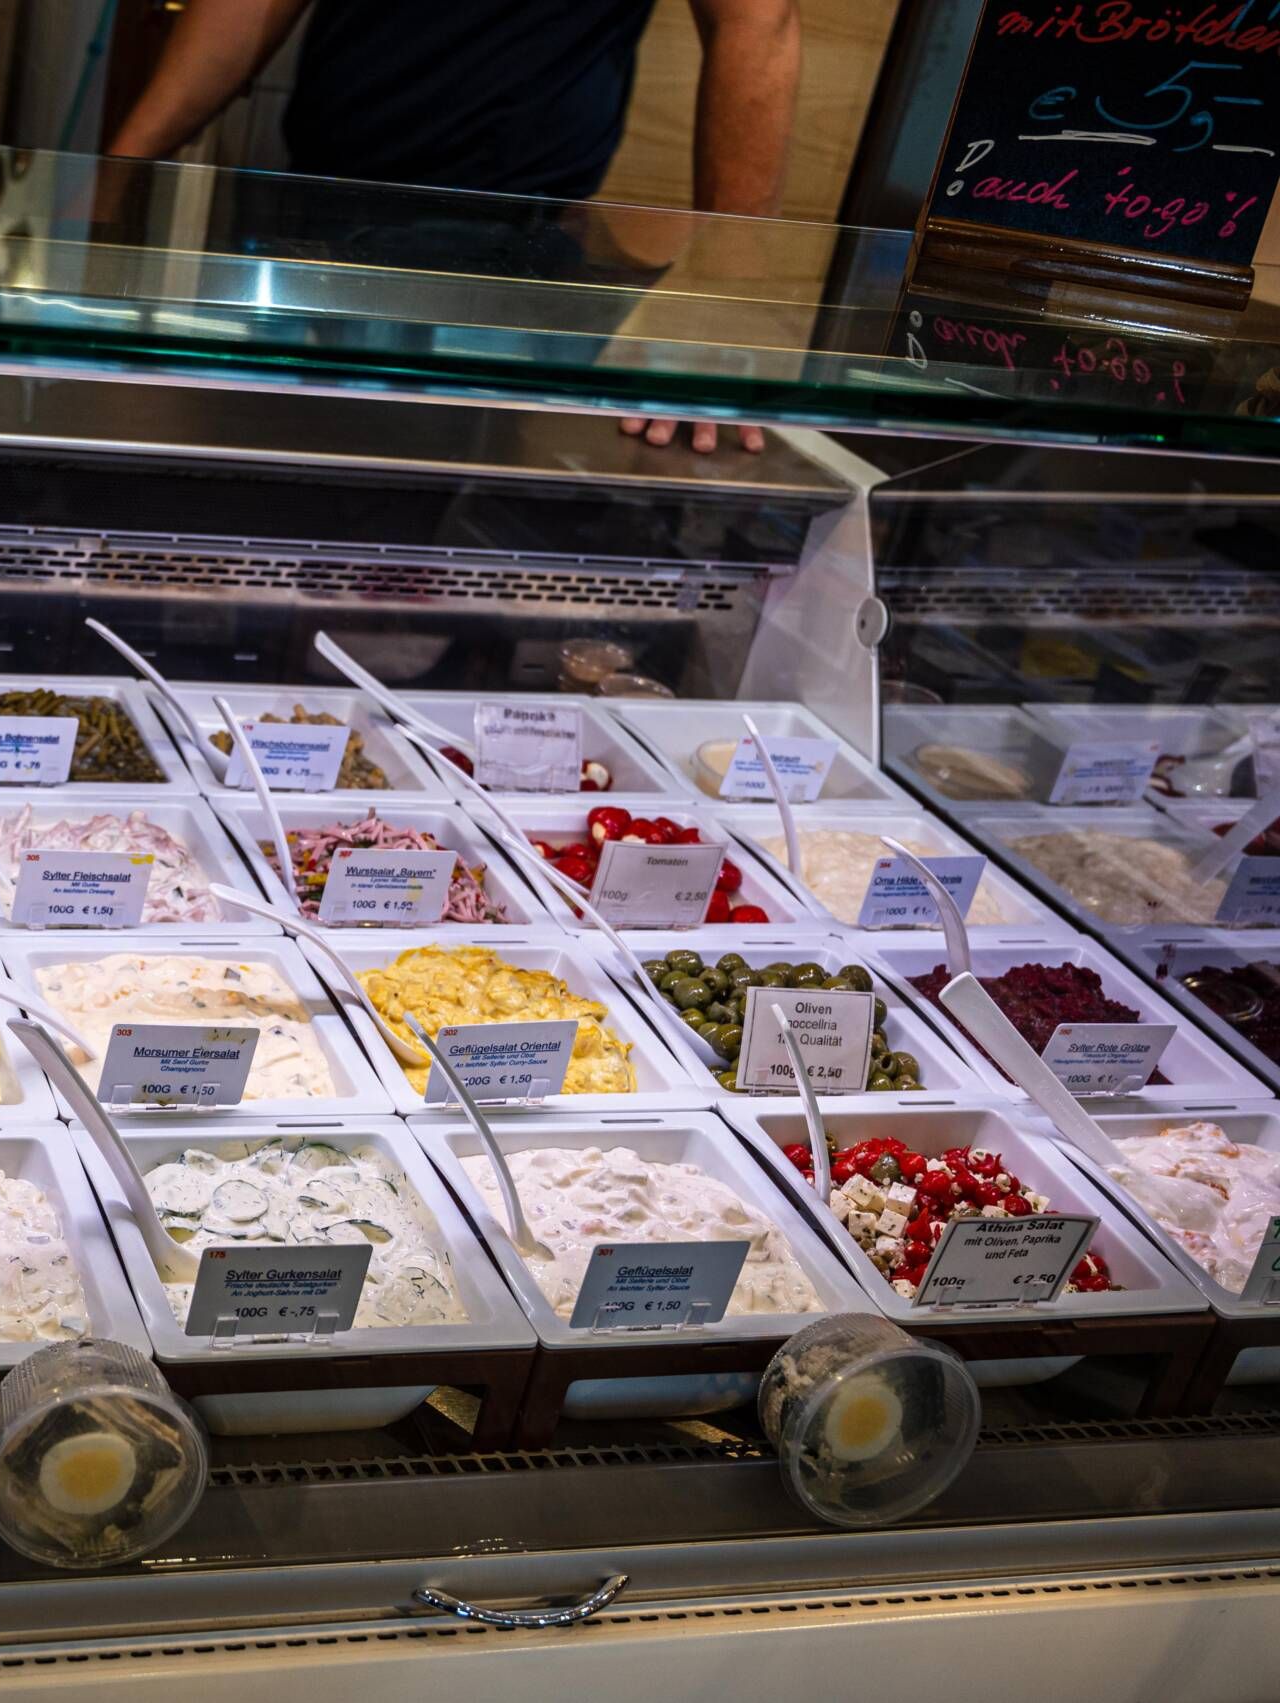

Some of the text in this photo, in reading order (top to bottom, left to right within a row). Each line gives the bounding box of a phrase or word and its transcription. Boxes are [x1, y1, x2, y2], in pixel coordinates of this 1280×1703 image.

[972, 169, 1079, 209] auch
[15, 760, 22, 769] €
[286, 766, 293, 775] €
[647, 856, 688, 866] Tomaten
[42, 870, 131, 882] Sylter Fleischsalat
[345, 866, 395, 877] Wurstsalat
[675, 892, 682, 901] €
[48, 905, 74, 914] 100G
[82, 906, 89, 914] €
[353, 900, 376, 908] 100G
[384, 901, 391, 909] €
[795, 1002, 832, 1014] Oliven
[116, 1029, 132, 1037] 303
[800, 1033, 842, 1047] Qualität
[134, 1047, 240, 1059] Morsumer Eiersalat
[449, 1041, 561, 1055] Geflügelsalat Oriental
[1068, 1043, 1151, 1053] Sylter Rote Grütze
[770, 1064, 842, 1078] 100g € 2,50
[499, 1075, 507, 1084] €
[510, 1074, 532, 1084] 1,50
[1067, 1075, 1090, 1083] 100G
[1097, 1075, 1105, 1083] €
[141, 1085, 215, 1096] 100G € 1,50
[976, 1220, 1065, 1233] Athina Salat
[964, 1237, 982, 1246] mit
[1021, 1234, 1062, 1245] Paprika
[985, 1249, 1029, 1260] und Feta
[225, 1268, 342, 1281] Sylter Gurkensalat
[616, 1266, 693, 1276] Geflügelsalat
[932, 1277, 966, 1290] 100g
[1013, 1275, 1023, 1284] €
[234, 1306, 315, 1318] 100G € -,75
[605, 1301, 680, 1312] 100G € 1,50
